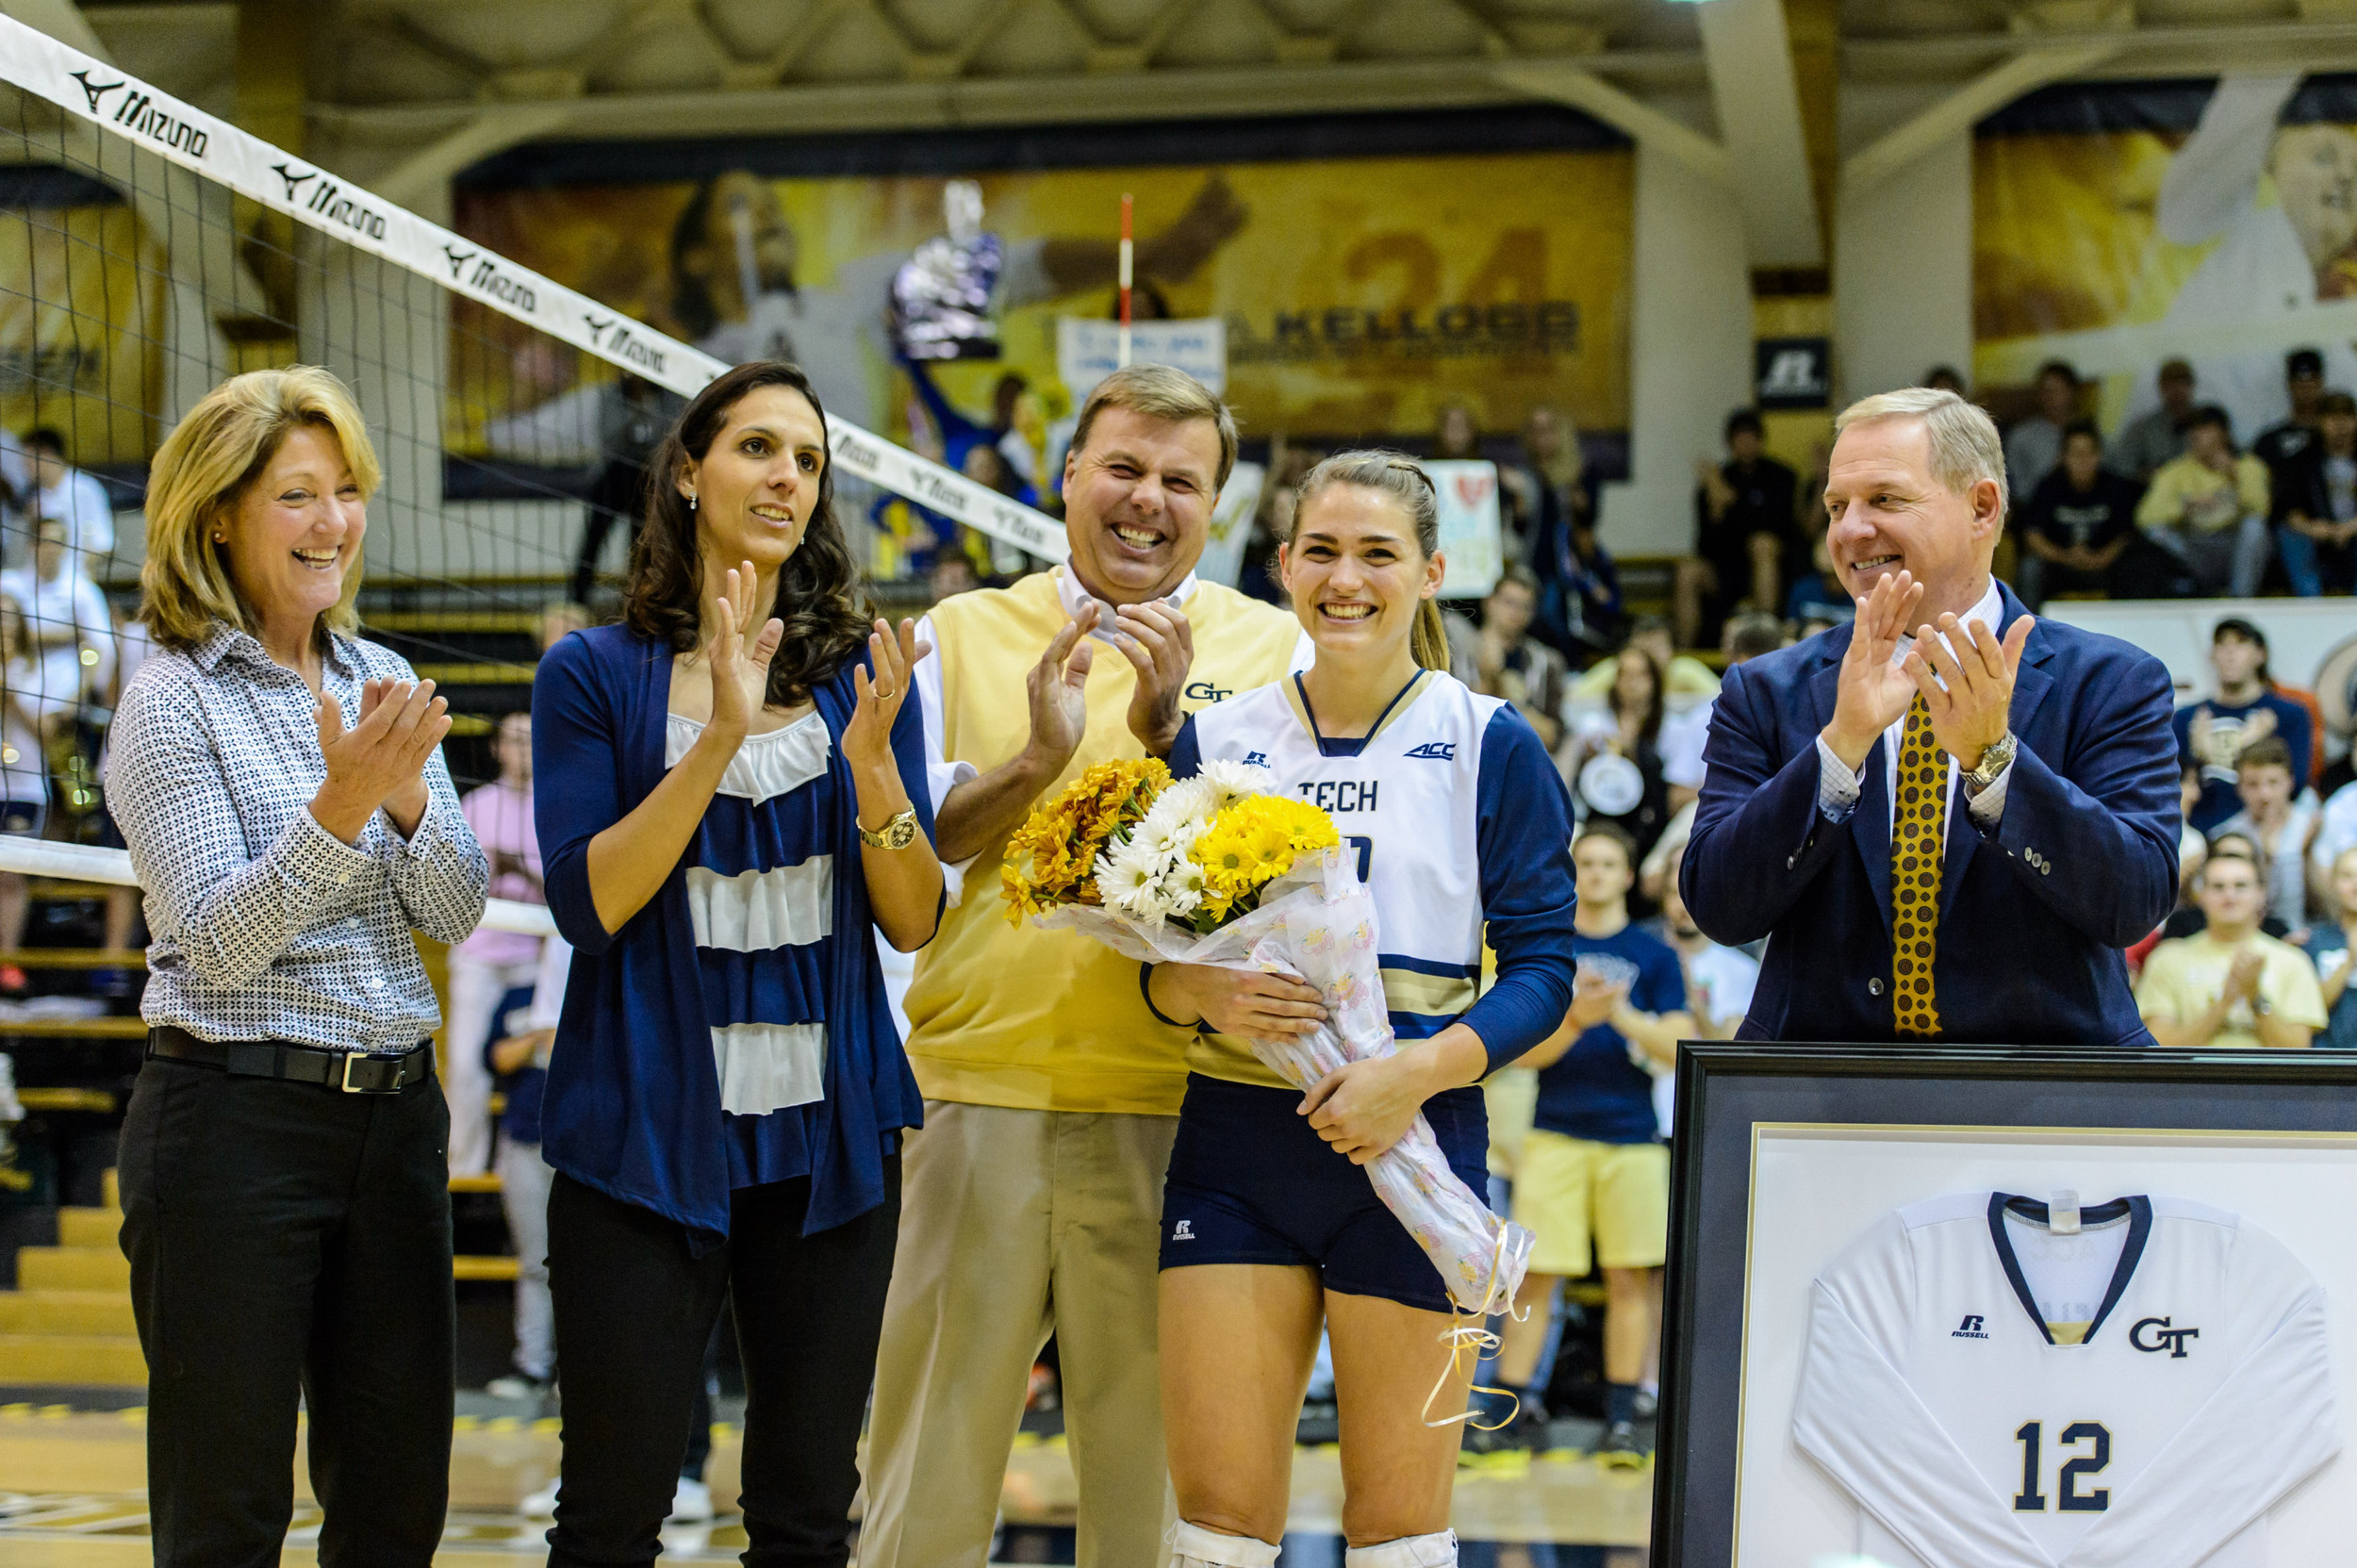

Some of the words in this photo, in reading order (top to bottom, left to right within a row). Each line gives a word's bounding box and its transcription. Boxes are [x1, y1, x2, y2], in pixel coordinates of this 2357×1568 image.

[114, 91, 207, 157] MIZUNO
[1185, 683, 1232, 703] GT
[1408, 742, 1457, 757] ACC
[1297, 780, 1378, 813] TECH
[1951, 1330, 1989, 1339] RUSSELL
[2129, 1316, 2200, 1358] GT
[2012, 1419, 2113, 1513] 12
